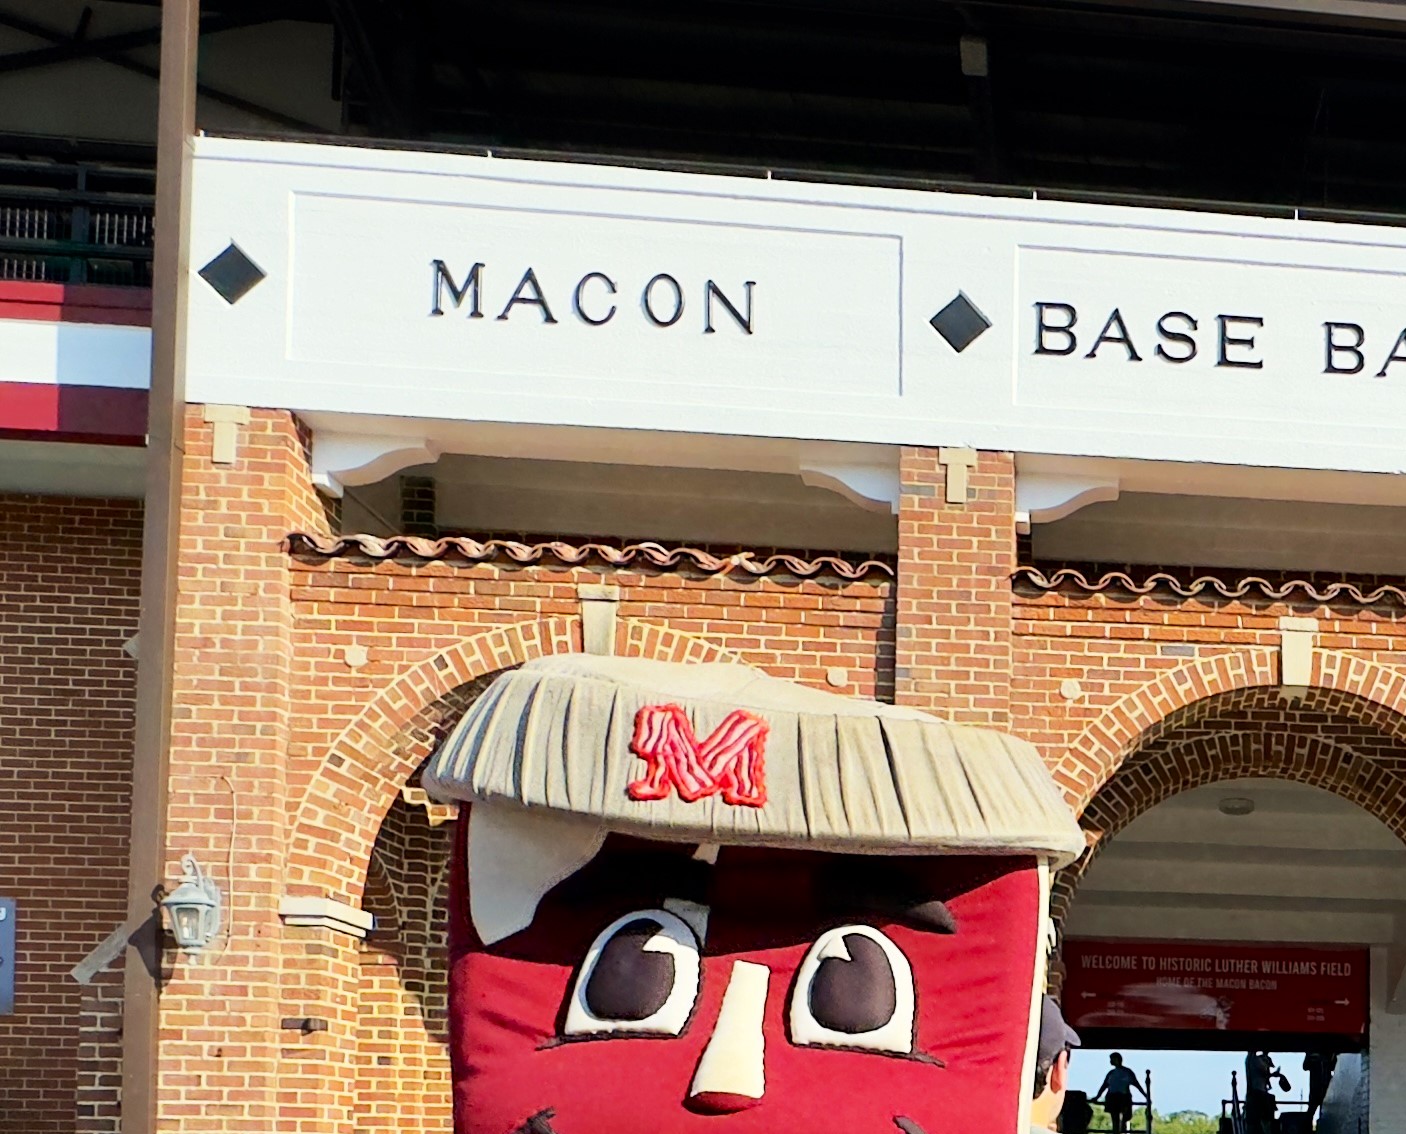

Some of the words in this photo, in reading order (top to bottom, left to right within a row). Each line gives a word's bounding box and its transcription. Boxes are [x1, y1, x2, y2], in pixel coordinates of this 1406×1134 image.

[430, 259, 758, 335] MACON
[1033, 300, 1265, 370] BASE
[627, 703, 770, 808] M
[1081, 954, 1138, 971] WELCOME
[1142, 956, 1157, 971] TO
[1159, 957, 1212, 973] HISTORIC
[1215, 958, 1258, 974] LUTHER
[1262, 960, 1317, 976] WILLIAMS
[1320, 962, 1352, 977] FIELD
[1184, 977, 1195, 988] OF
[1197, 977, 1214, 989] THE
[1216, 978, 1247, 990] MACON
[1249, 979, 1278, 991] BACON
